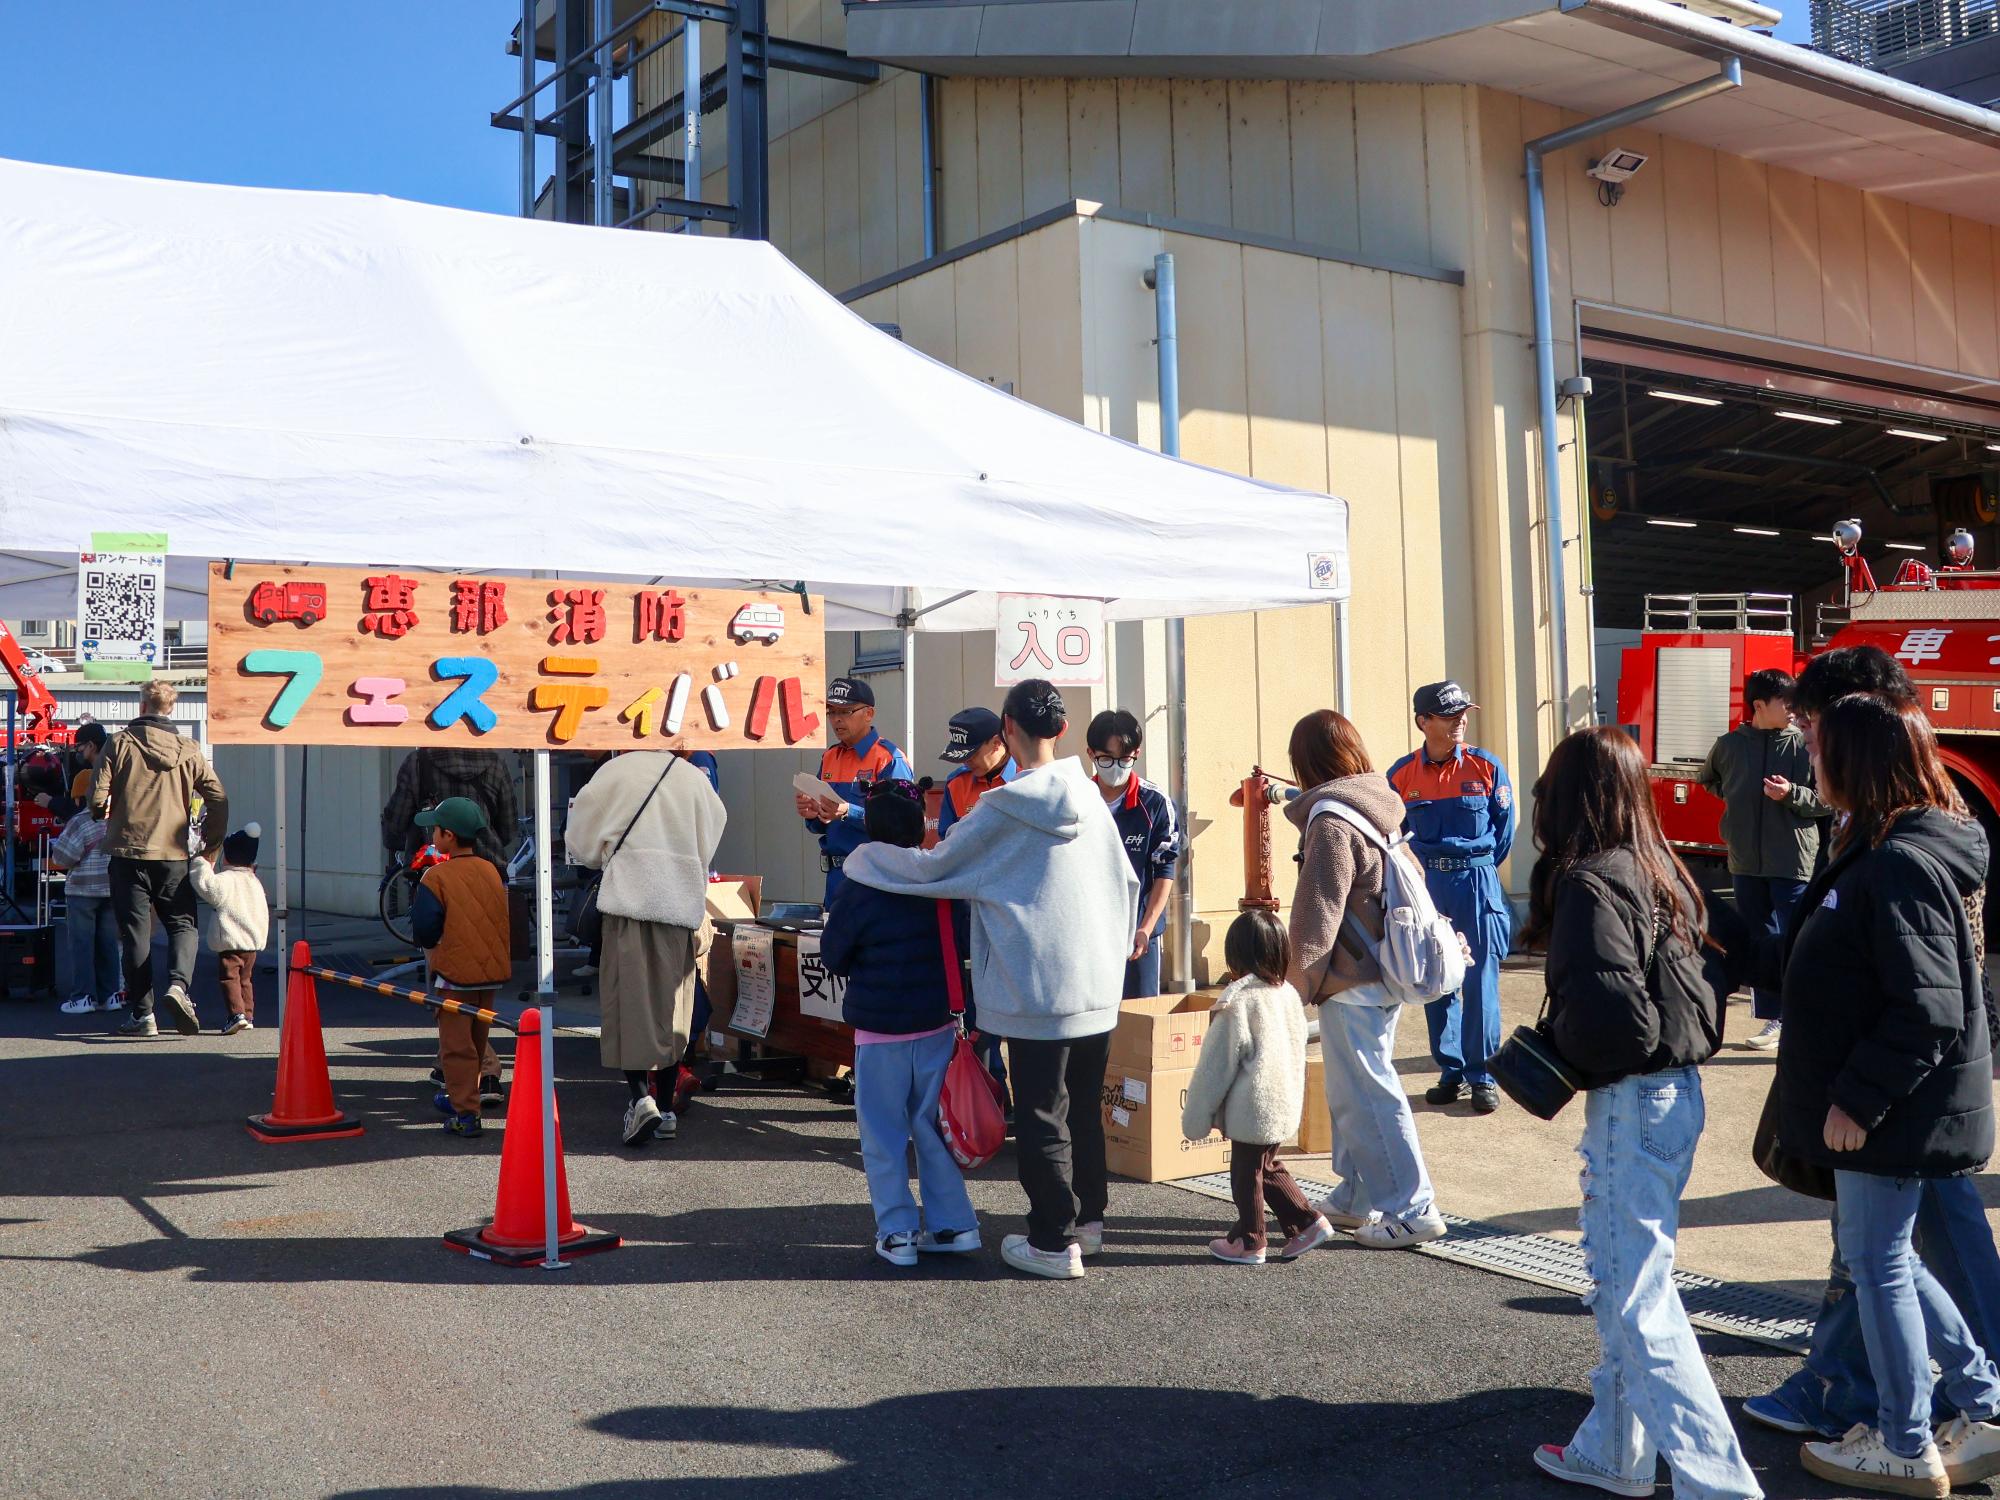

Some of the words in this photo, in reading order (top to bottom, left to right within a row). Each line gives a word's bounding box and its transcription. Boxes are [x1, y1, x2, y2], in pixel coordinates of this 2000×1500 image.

[98, 553, 147, 564] アンケート
[364, 574, 687, 644] 恵那消防
[1028, 609, 1077, 620] いりぐち
[1009, 621, 1091, 670] 入口
[245, 650, 820, 743] フェスティバル
[834, 687, 850, 697] CITY
[112, 702, 118, 711] 2
